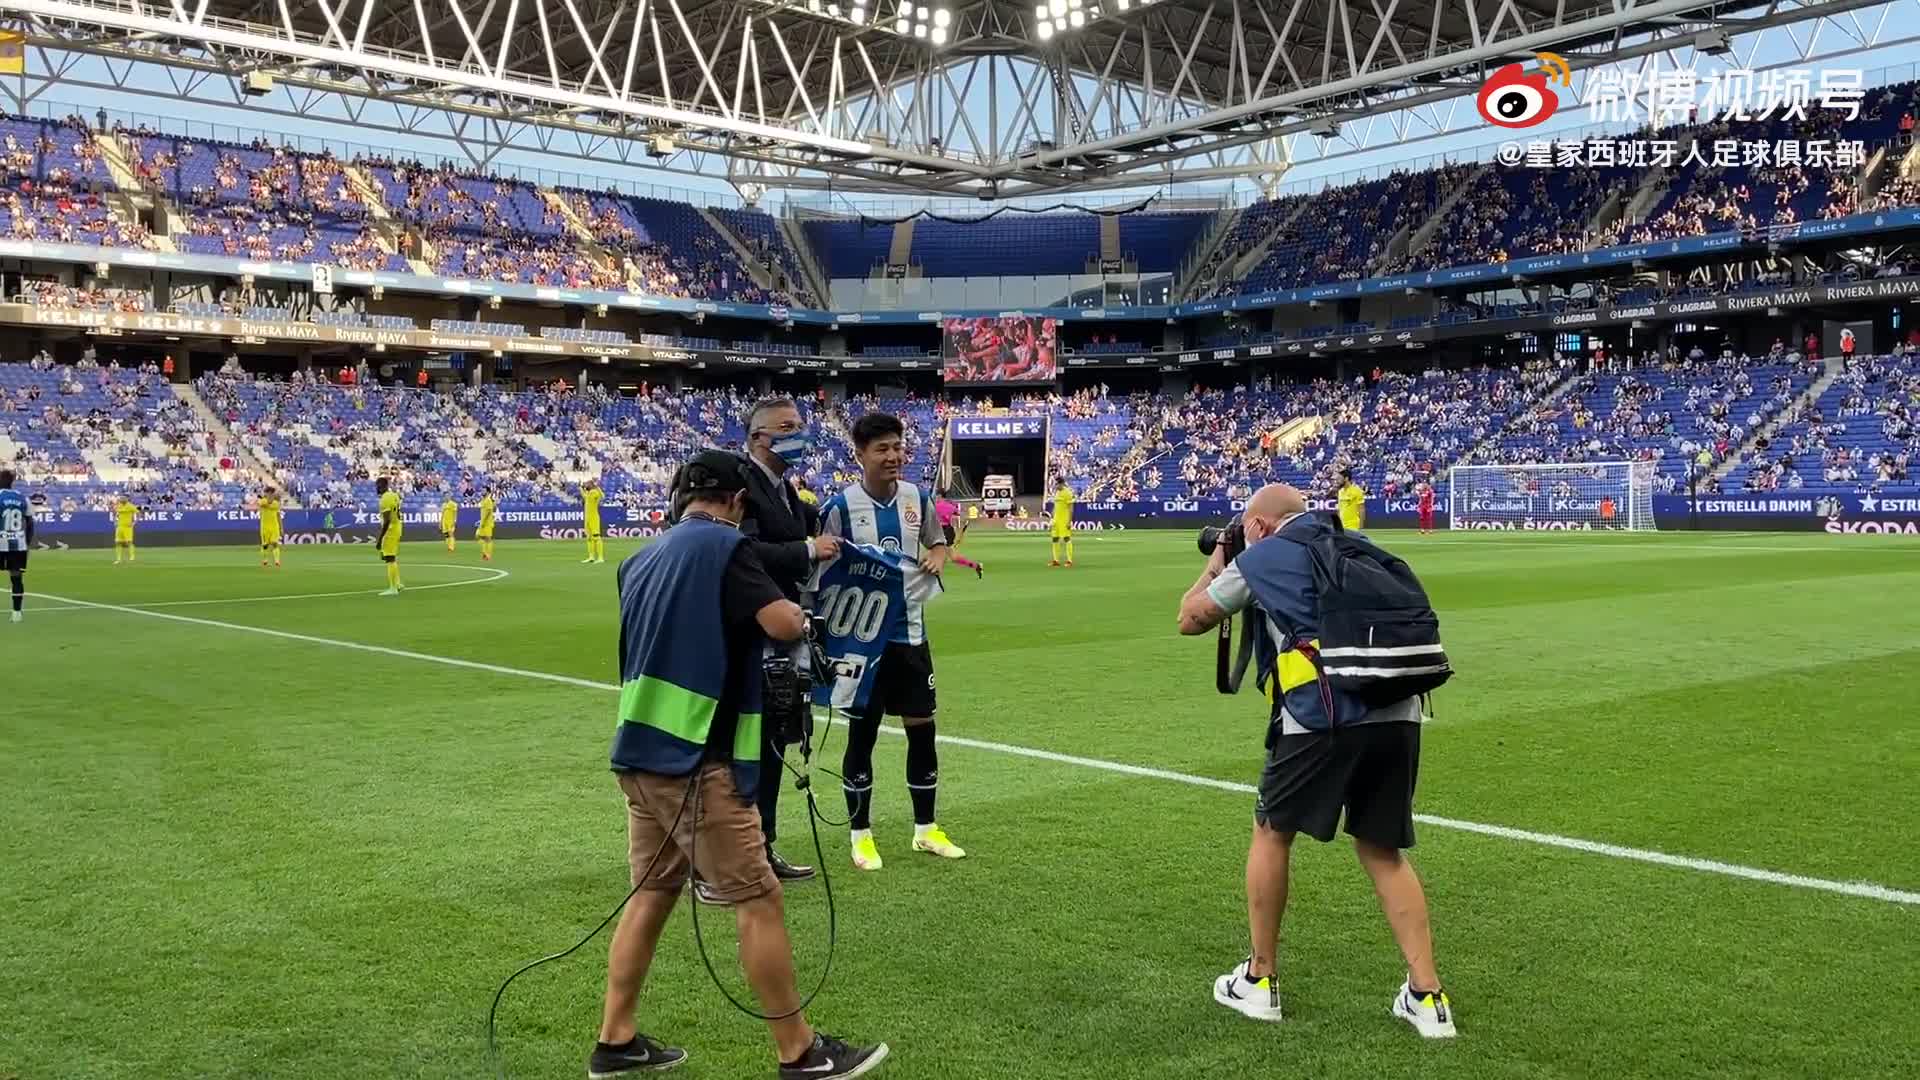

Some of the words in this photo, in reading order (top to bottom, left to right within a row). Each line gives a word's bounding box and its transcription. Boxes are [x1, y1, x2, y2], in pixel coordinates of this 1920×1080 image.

[1827, 285, 1874, 300] RIVIERA
[1879, 280, 1920, 295] MAYA
[1728, 296, 1771, 311] RIVIERA
[1775, 291, 1811, 305] MAYA
[36, 311, 107, 326] KELME
[138, 315, 206, 331] KELME
[241, 322, 282, 336] RIVIERA
[286, 326, 320, 338] MAYA
[335, 328, 374, 342] RIVIERA
[377, 332, 408, 344] MAYA
[957, 422, 1024, 435] KELME
[1087, 502, 1117, 511] KELME
[1163, 500, 1199, 512] DIGI
[1305, 499, 1339, 512] DIG
[1481, 499, 1527, 512] CaixaBank
[1705, 500, 1768, 512] ESTRELLA
[1769, 499, 1812, 512] DAMM
[2, 508, 22, 531] 18
[506, 511, 552, 522] ESTRELLA
[554, 511, 584, 522] DAMM
[1071, 520, 1104, 531] KODA
[1825, 516, 1920, 533] ŠKODA
[283, 532, 344, 545] KODA
[818, 583, 889, 642] 100
